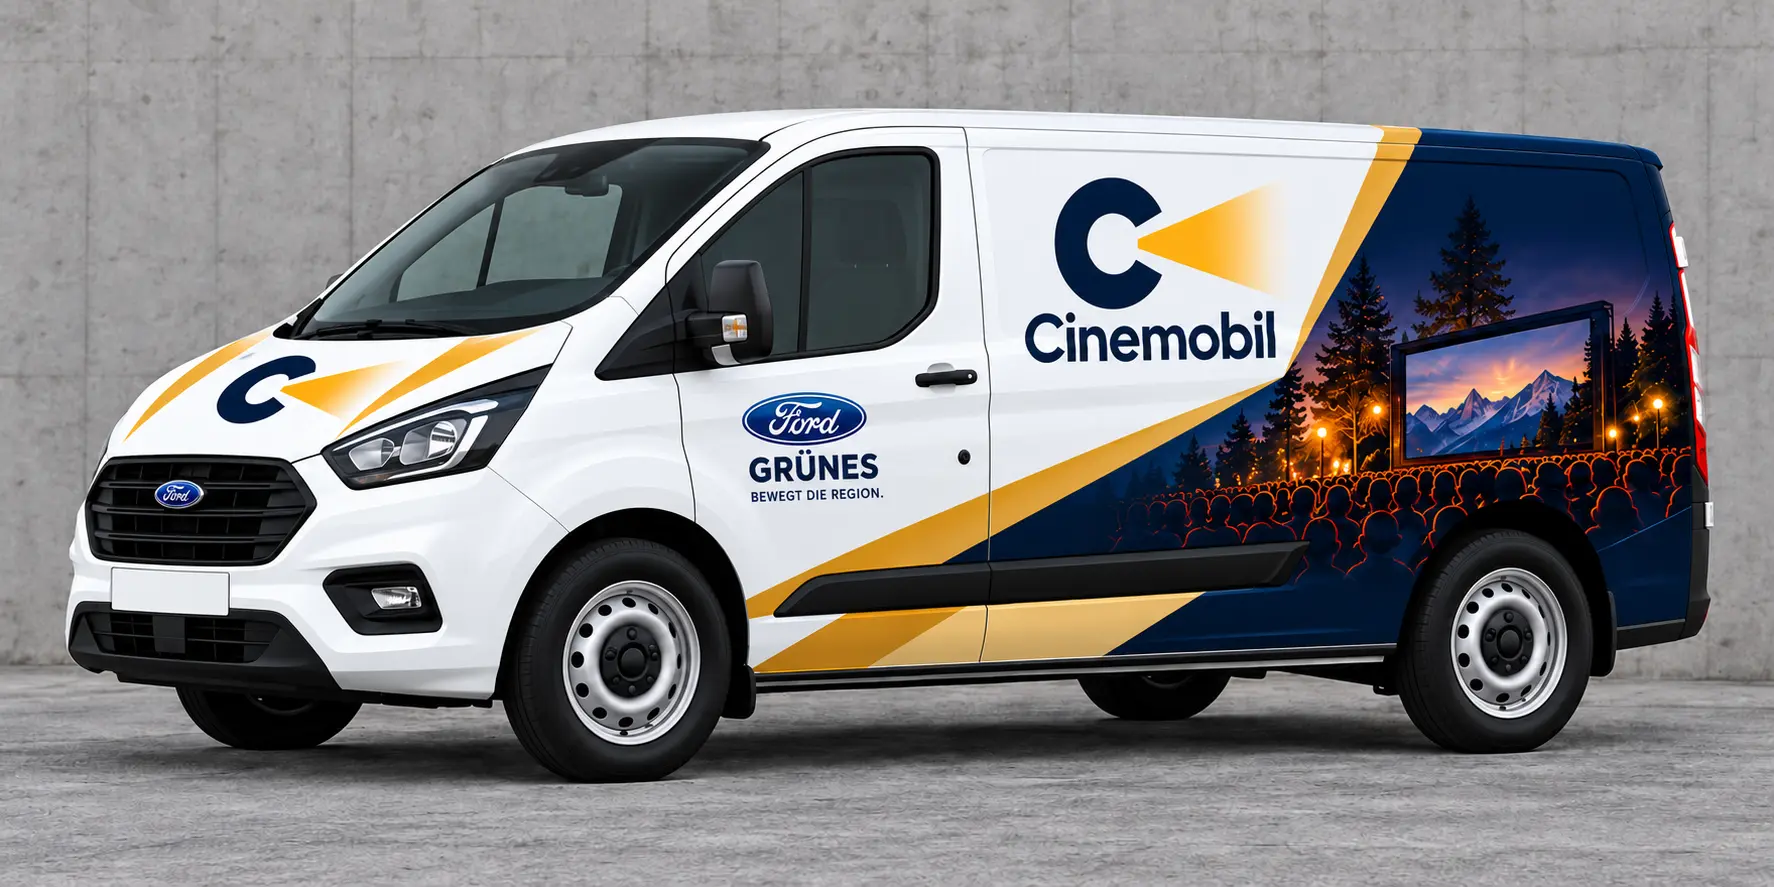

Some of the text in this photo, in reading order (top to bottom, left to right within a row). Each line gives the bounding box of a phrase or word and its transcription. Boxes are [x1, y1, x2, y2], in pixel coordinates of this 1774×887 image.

[1054, 177, 1163, 310] C
[1025, 310, 1277, 364] Cinemobil
[216, 355, 317, 424] C
[768, 401, 842, 436] Ford
[749, 449, 879, 483] GRÜNES
[162, 484, 191, 502] Ford
[751, 487, 884, 502] BEWEGT DIE REGION.
